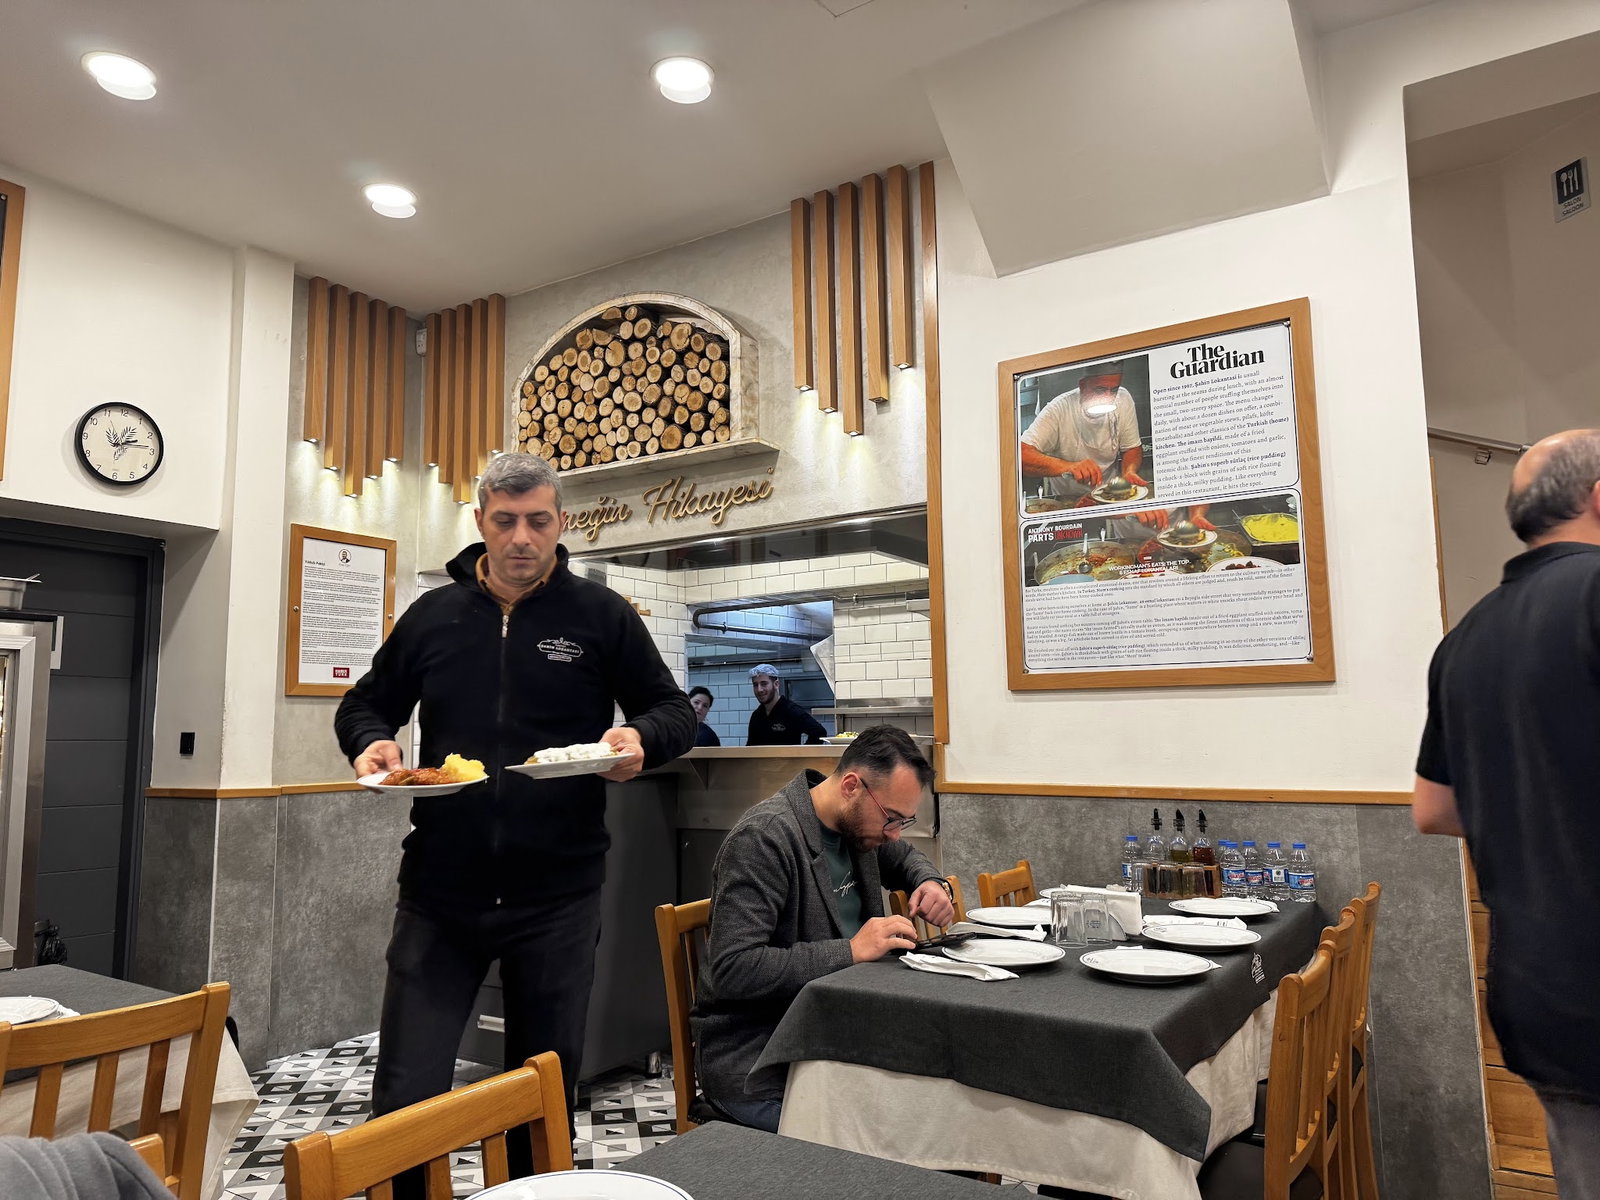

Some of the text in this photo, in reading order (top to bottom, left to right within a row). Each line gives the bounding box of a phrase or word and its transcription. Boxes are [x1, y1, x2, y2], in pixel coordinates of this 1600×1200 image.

[1187, 344, 1224, 362] The
[1170, 350, 1264, 378] Guardian
[1265, 374, 1284, 382] almost
[1201, 393, 1218, 403] people
[1241, 385, 1270, 394] themselves
[104, 408, 111, 417] 11
[121, 409, 128, 417] 12
[1199, 417, 1223, 427] vegetable
[1247, 418, 1268, 427] Turkish
[1269, 415, 1288, 425] (home)
[1210, 458, 1229, 467] superb
[1212, 467, 1228, 476] grains
[1247, 469, 1276, 478] everything
[642, 468, 774, 526] Hikayesi
[1028, 532, 1054, 542] PARTS
